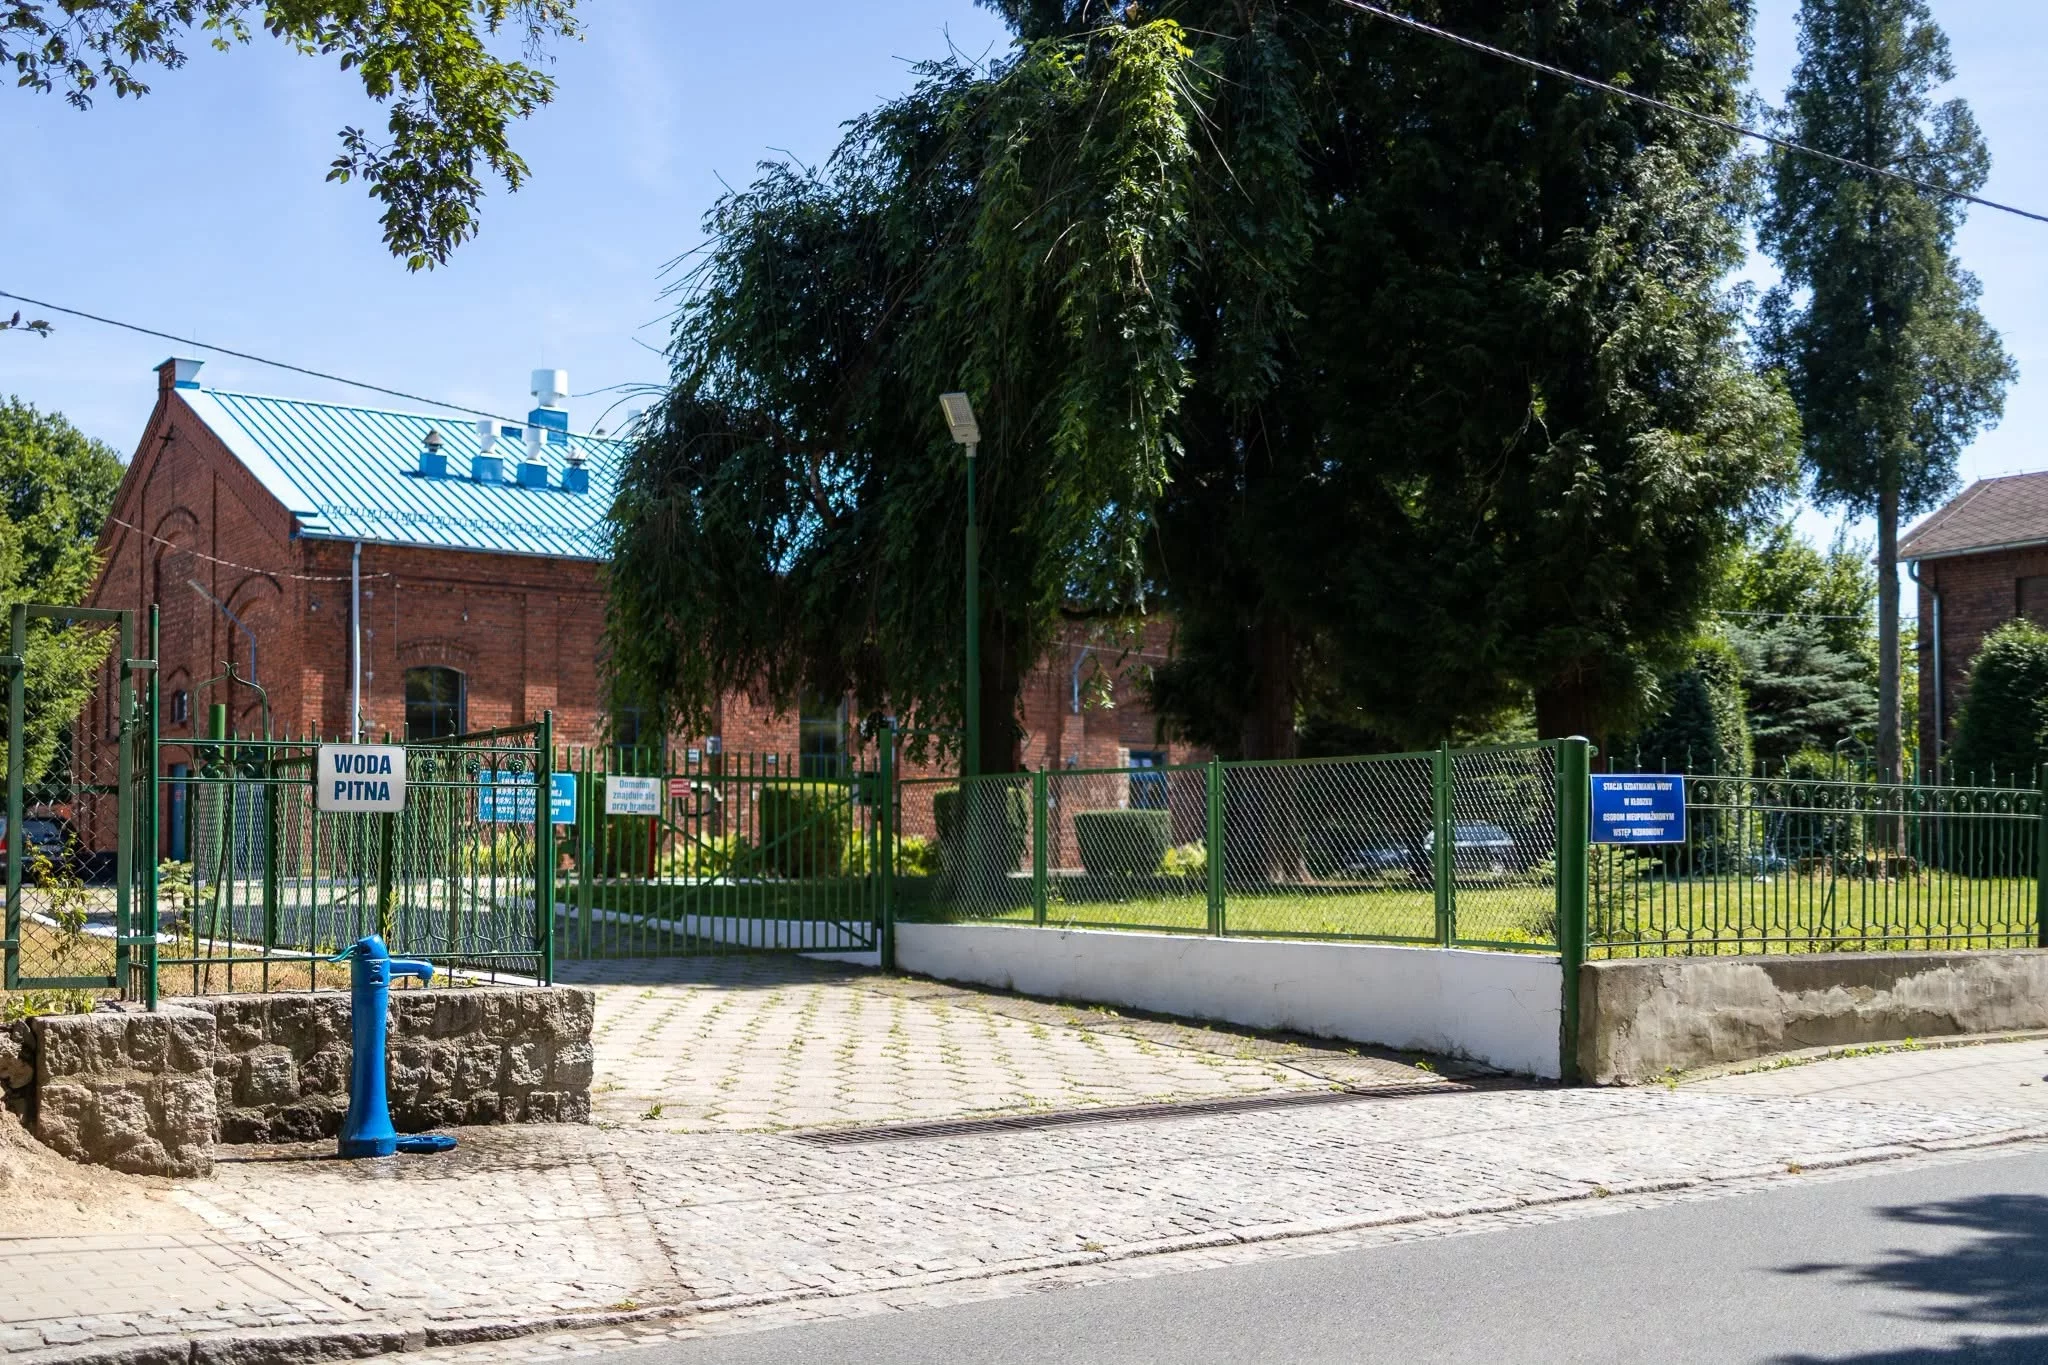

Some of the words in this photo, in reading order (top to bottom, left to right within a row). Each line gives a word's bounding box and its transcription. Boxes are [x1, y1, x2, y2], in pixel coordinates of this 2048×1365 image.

[334, 754, 392, 774] WODA
[619, 779, 650, 789] Domofon
[334, 781, 390, 801] PITNA
[613, 790, 643, 800] znajduje
[645, 791, 655, 802] się
[612, 803, 627, 811] przy
[1624, 798, 1629, 806] W
[1603, 813, 1625, 821] OSOBOM
[1613, 828, 1631, 838] WSTĘP
